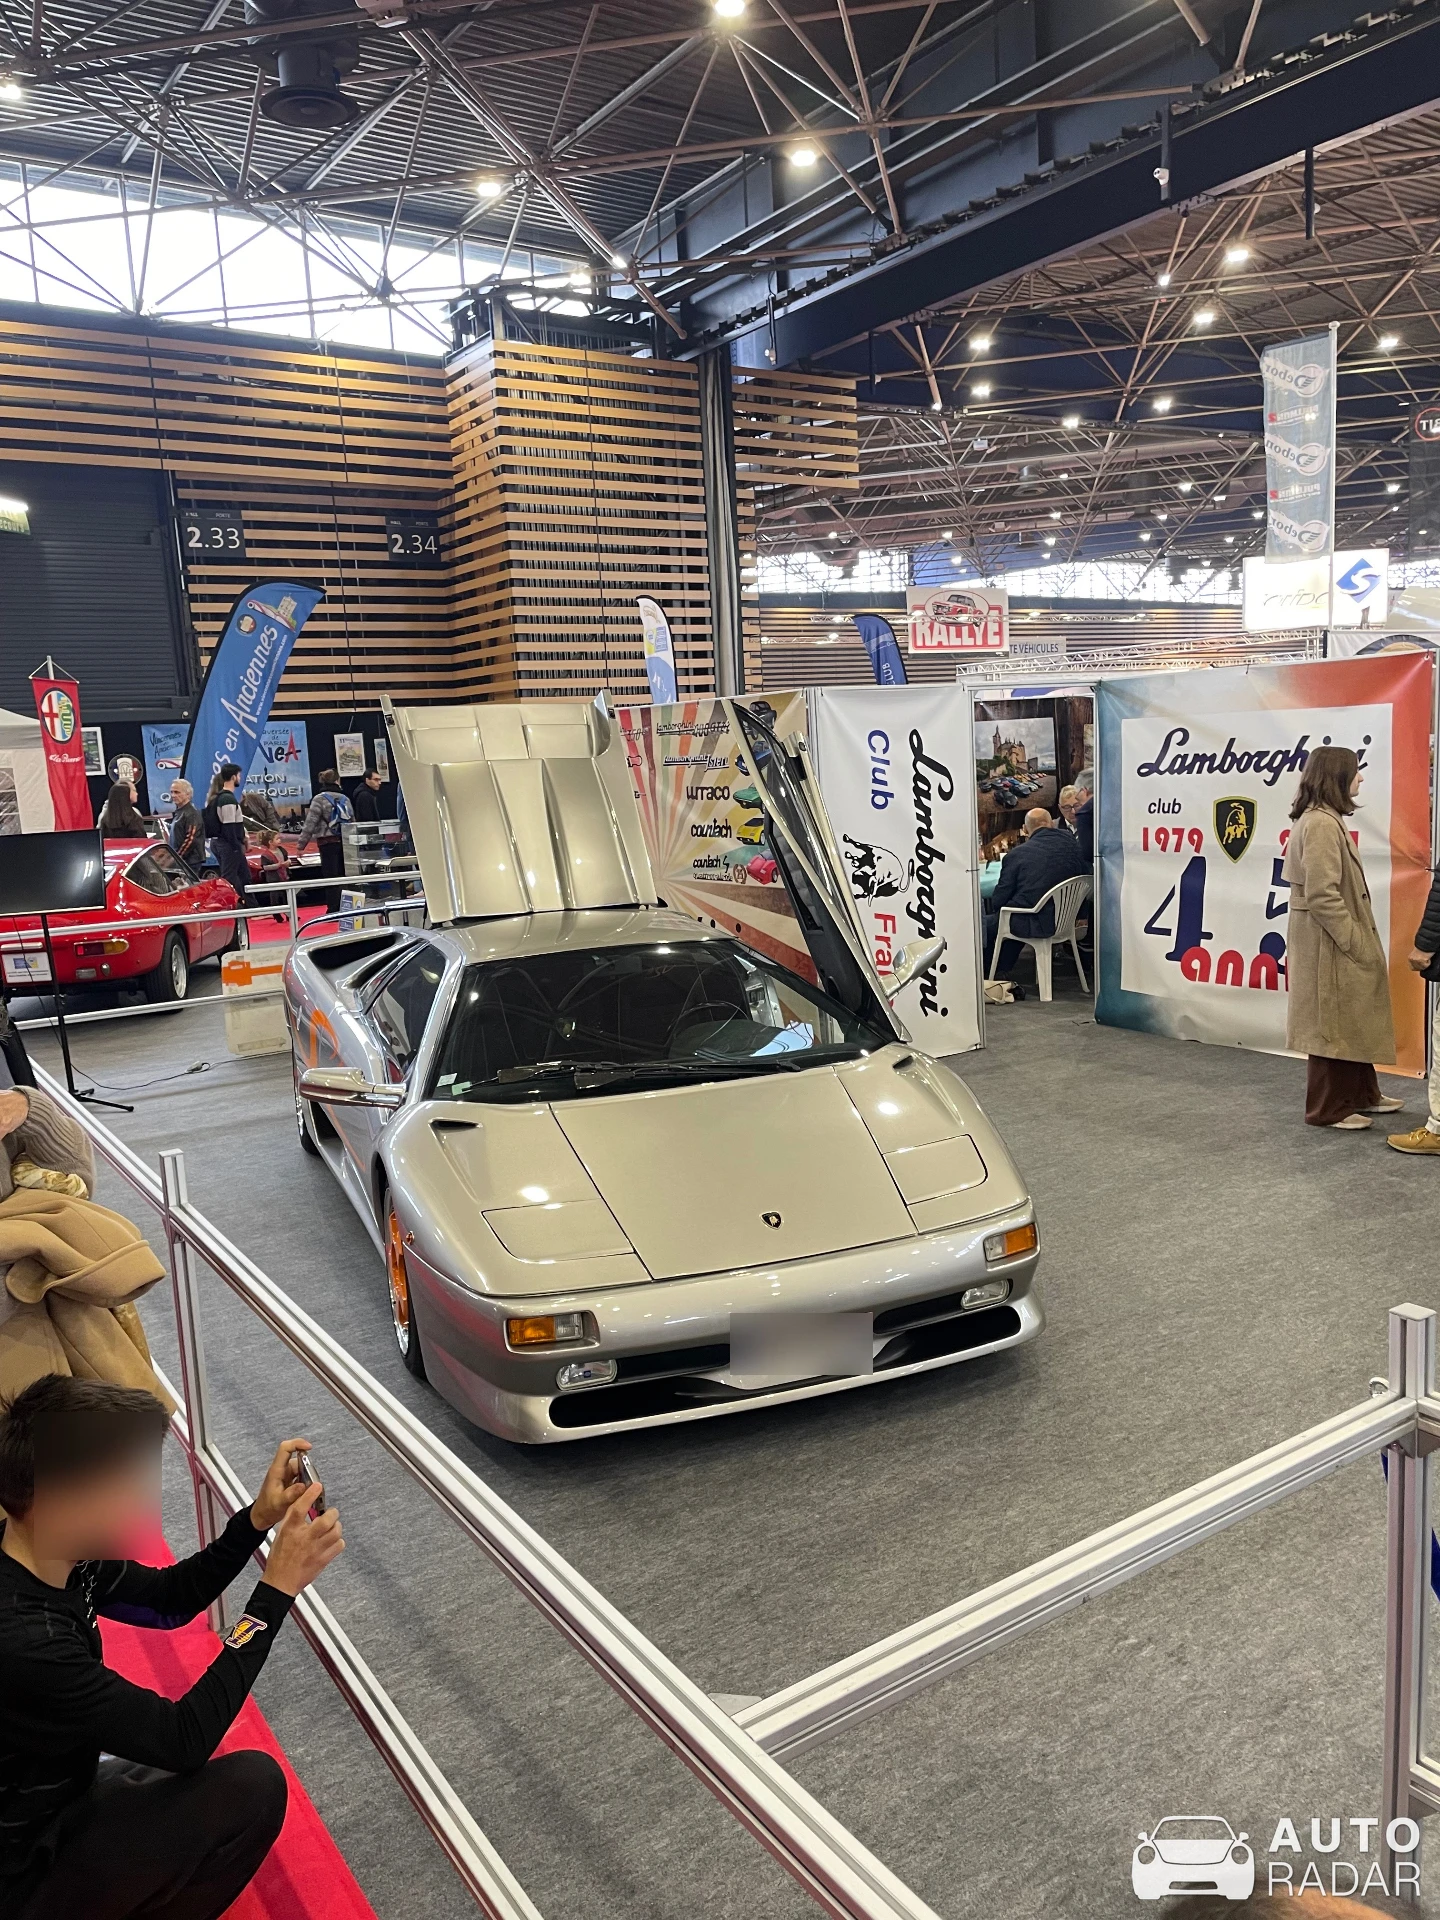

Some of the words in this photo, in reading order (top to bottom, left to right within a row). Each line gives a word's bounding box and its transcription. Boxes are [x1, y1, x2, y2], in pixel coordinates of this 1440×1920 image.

[186, 526, 241, 548] 2.33
[391, 534, 438, 555] 2.34
[916, 609, 1001, 647] RALLYE
[1019, 642, 1059, 654] VÉHICULES
[221, 624, 279, 740] Anciennes
[226, 728, 240, 752] en
[867, 729, 895, 810] Club
[1148, 797, 1182, 815] club
[690, 818, 732, 838] countach
[1142, 827, 1204, 854] 1979
